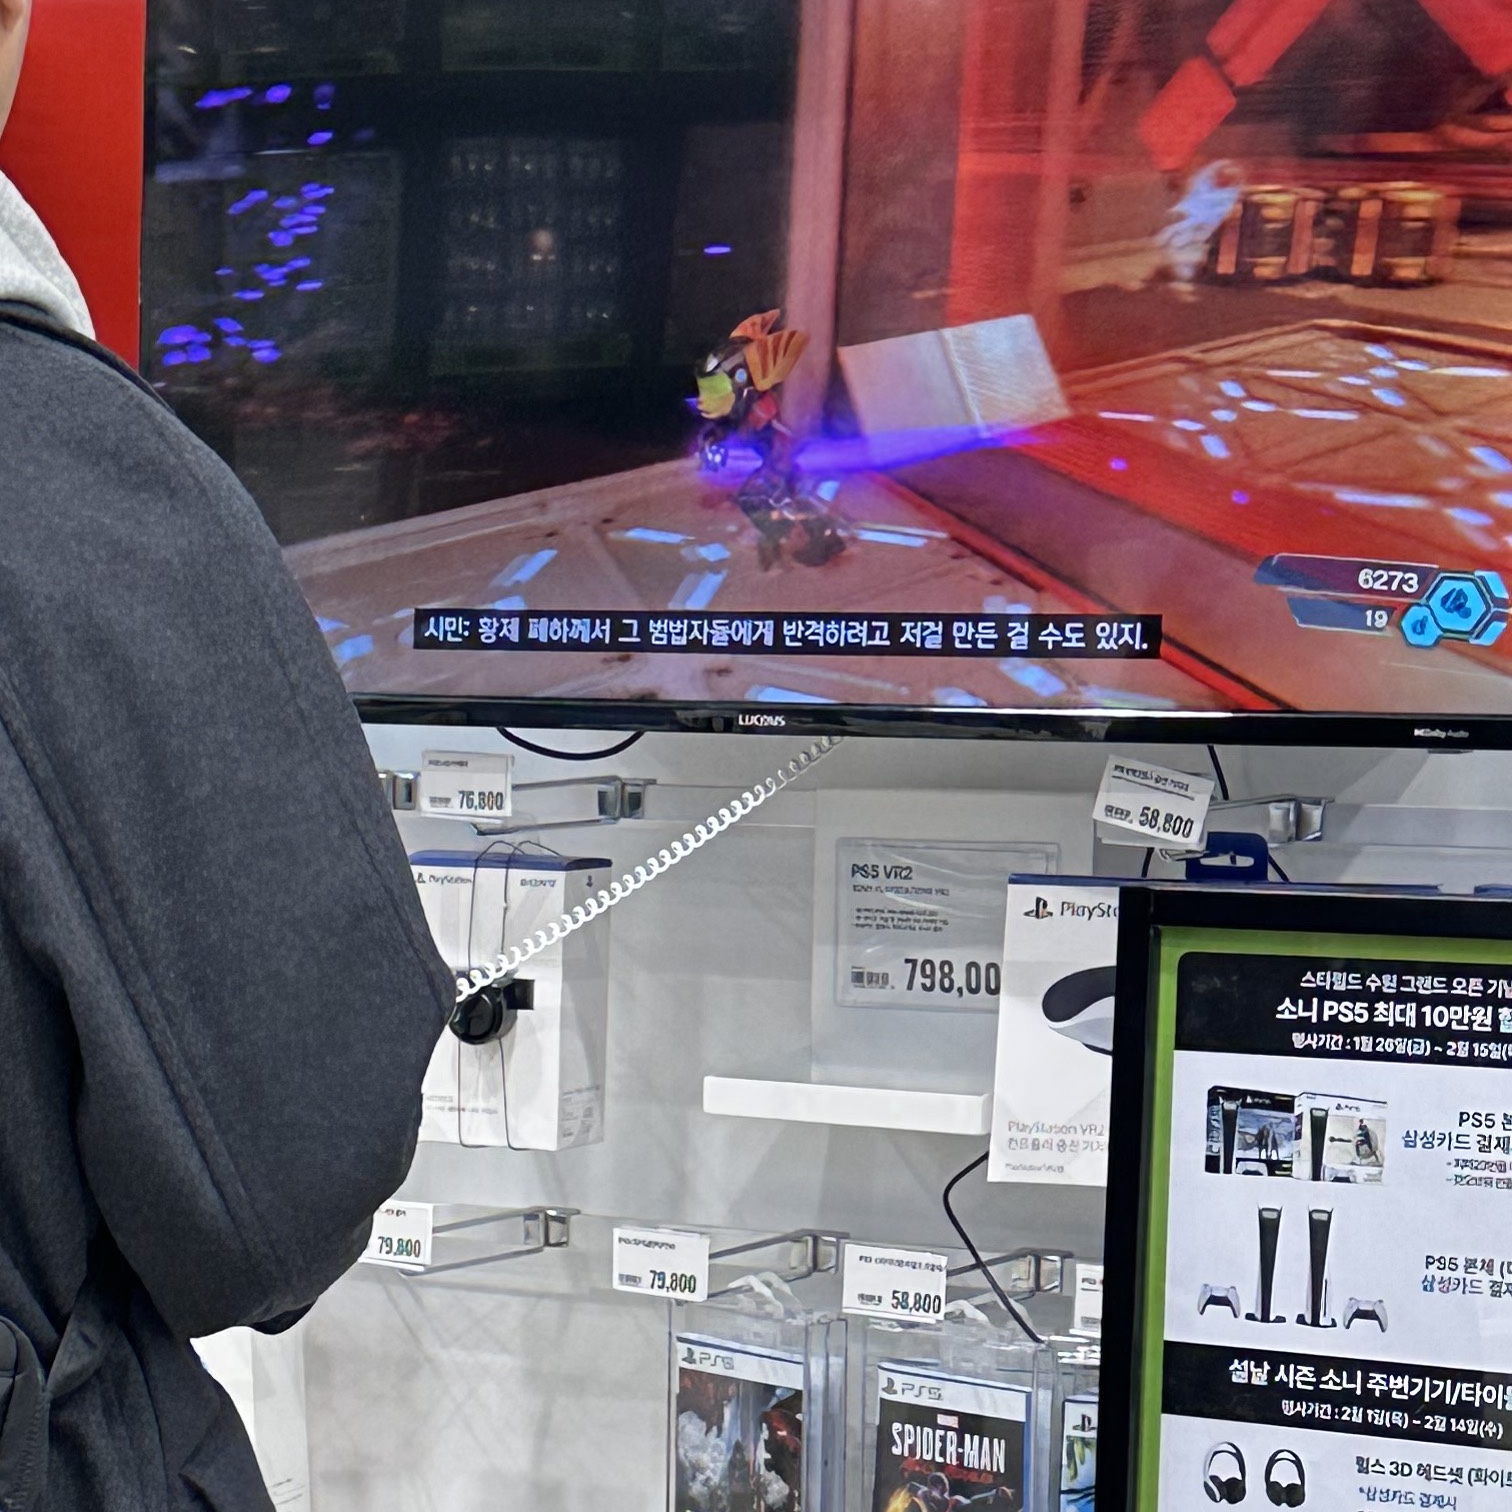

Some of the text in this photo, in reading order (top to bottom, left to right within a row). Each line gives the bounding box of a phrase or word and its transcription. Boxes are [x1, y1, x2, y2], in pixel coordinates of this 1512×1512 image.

[1357, 567, 1420, 594] 6273
[1364, 609, 1389, 628] 19
[424, 616, 471, 642] 시민:
[477, 616, 520, 644] 황제
[617, 618, 641, 643] 그
[648, 618, 774, 648] 범법자들에게
[783, 620, 891, 648] 반격하려고
[899, 620, 944, 650] 저걸
[952, 621, 999, 650] 만든
[1006, 622, 1029, 650] 걸
[1037, 622, 1087, 651] 수도
[1094, 622, 1150, 651] 있지.
[1138, 805, 1195, 839] 58,800
[883, 864, 914, 881] VR2
[903, 957, 1001, 998] 798,00
[1275, 996, 1319, 1024] 소니
[1322, 1000, 1370, 1024] PS5
[1372, 1000, 1417, 1029] 최대
[1420, 1004, 1493, 1033] 10만원
[1458, 1111, 1496, 1129] PS5
[1401, 1129, 1472, 1151] 삼성카드
[648, 1269, 697, 1294] 79,800
[890, 1289, 942, 1315] 58,800
[698, 1351, 736, 1371] PS5
[1228, 1357, 1271, 1387] 설날
[1274, 1363, 1317, 1391] 시즌
[1319, 1368, 1362, 1396] 소니
[900, 1381, 944, 1402] PS5
[891, 1421, 1006, 1474] SPIDER-MAN
[1388, 1460, 1413, 1477] 3D
[1416, 1462, 1464, 1486] 헤드셋
